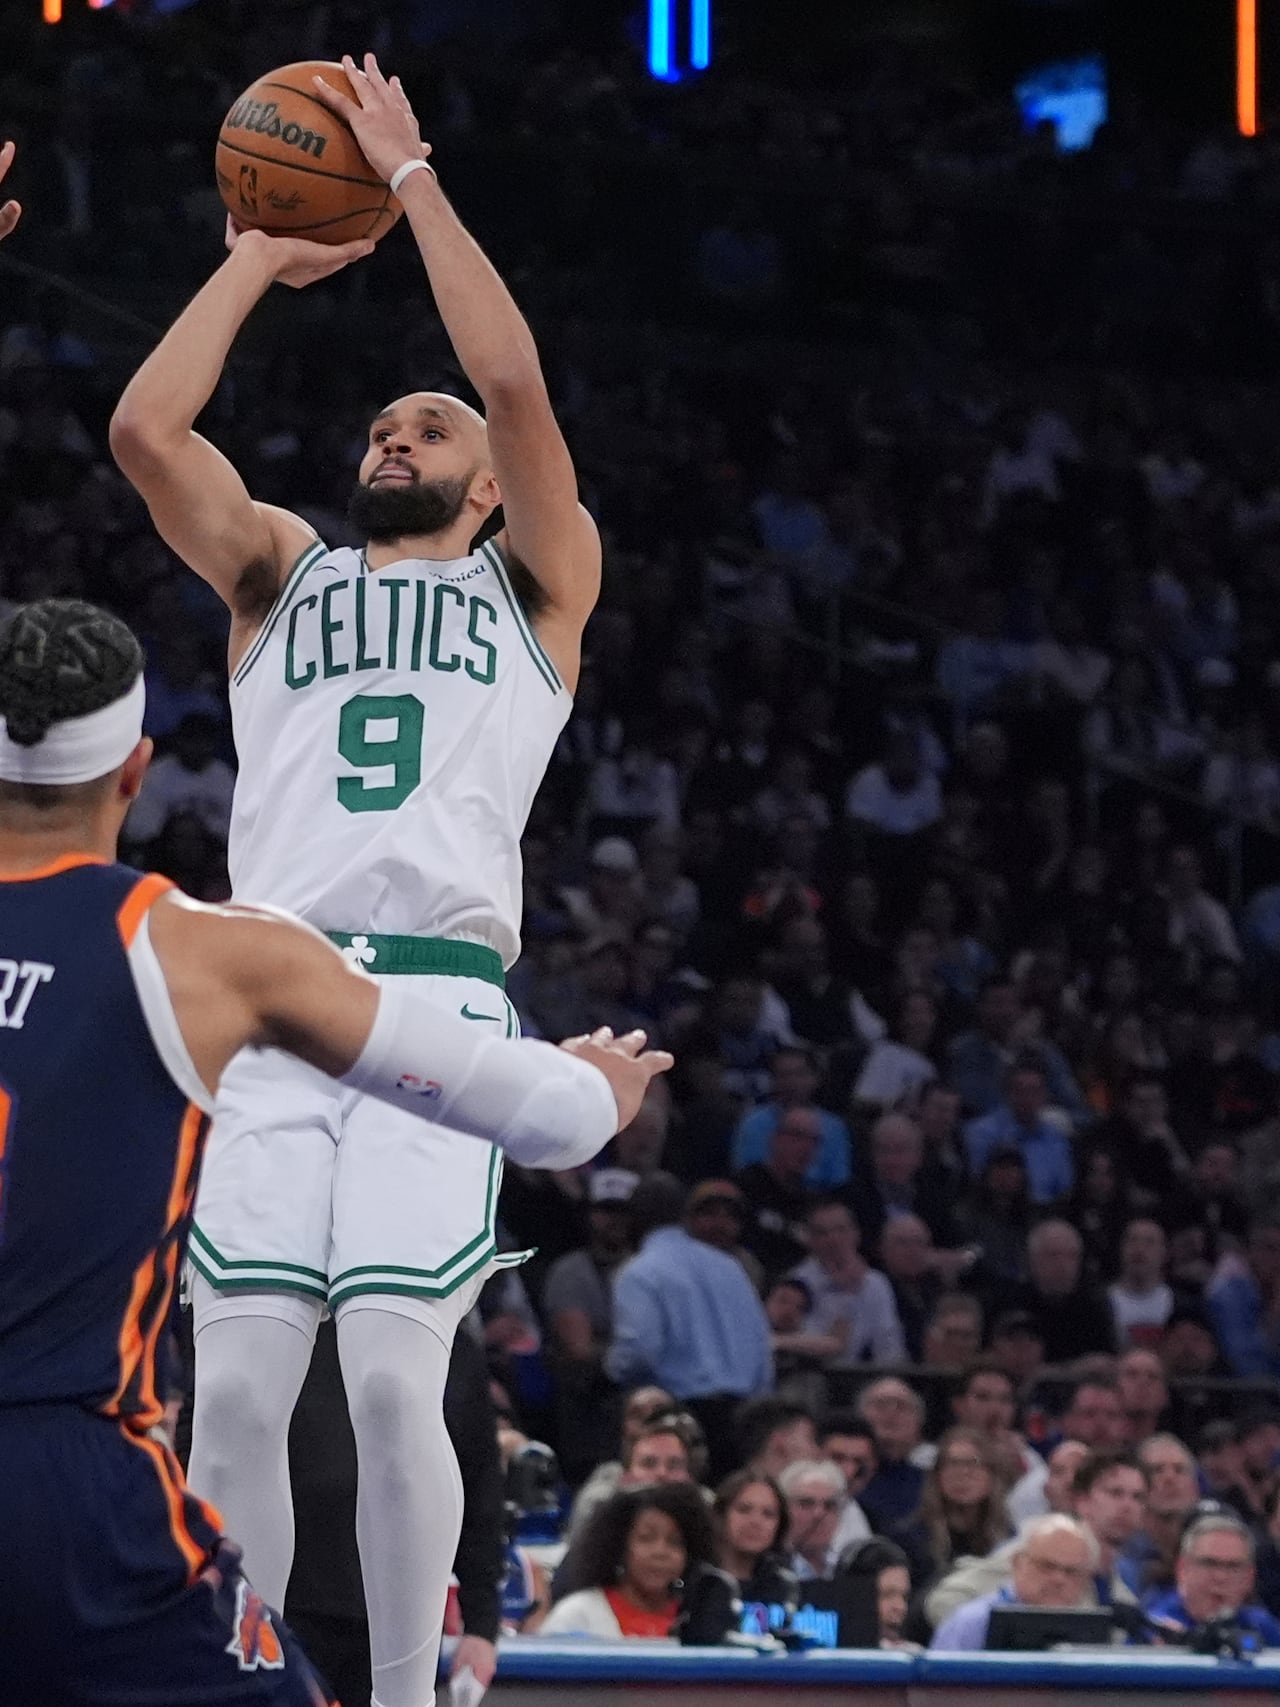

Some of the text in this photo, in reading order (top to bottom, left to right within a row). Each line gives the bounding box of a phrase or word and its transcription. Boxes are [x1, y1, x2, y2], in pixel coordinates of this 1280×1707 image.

[224, 97, 327, 159] Wilson
[285, 577, 497, 690] CELTICS
[337, 693, 425, 813] 9
